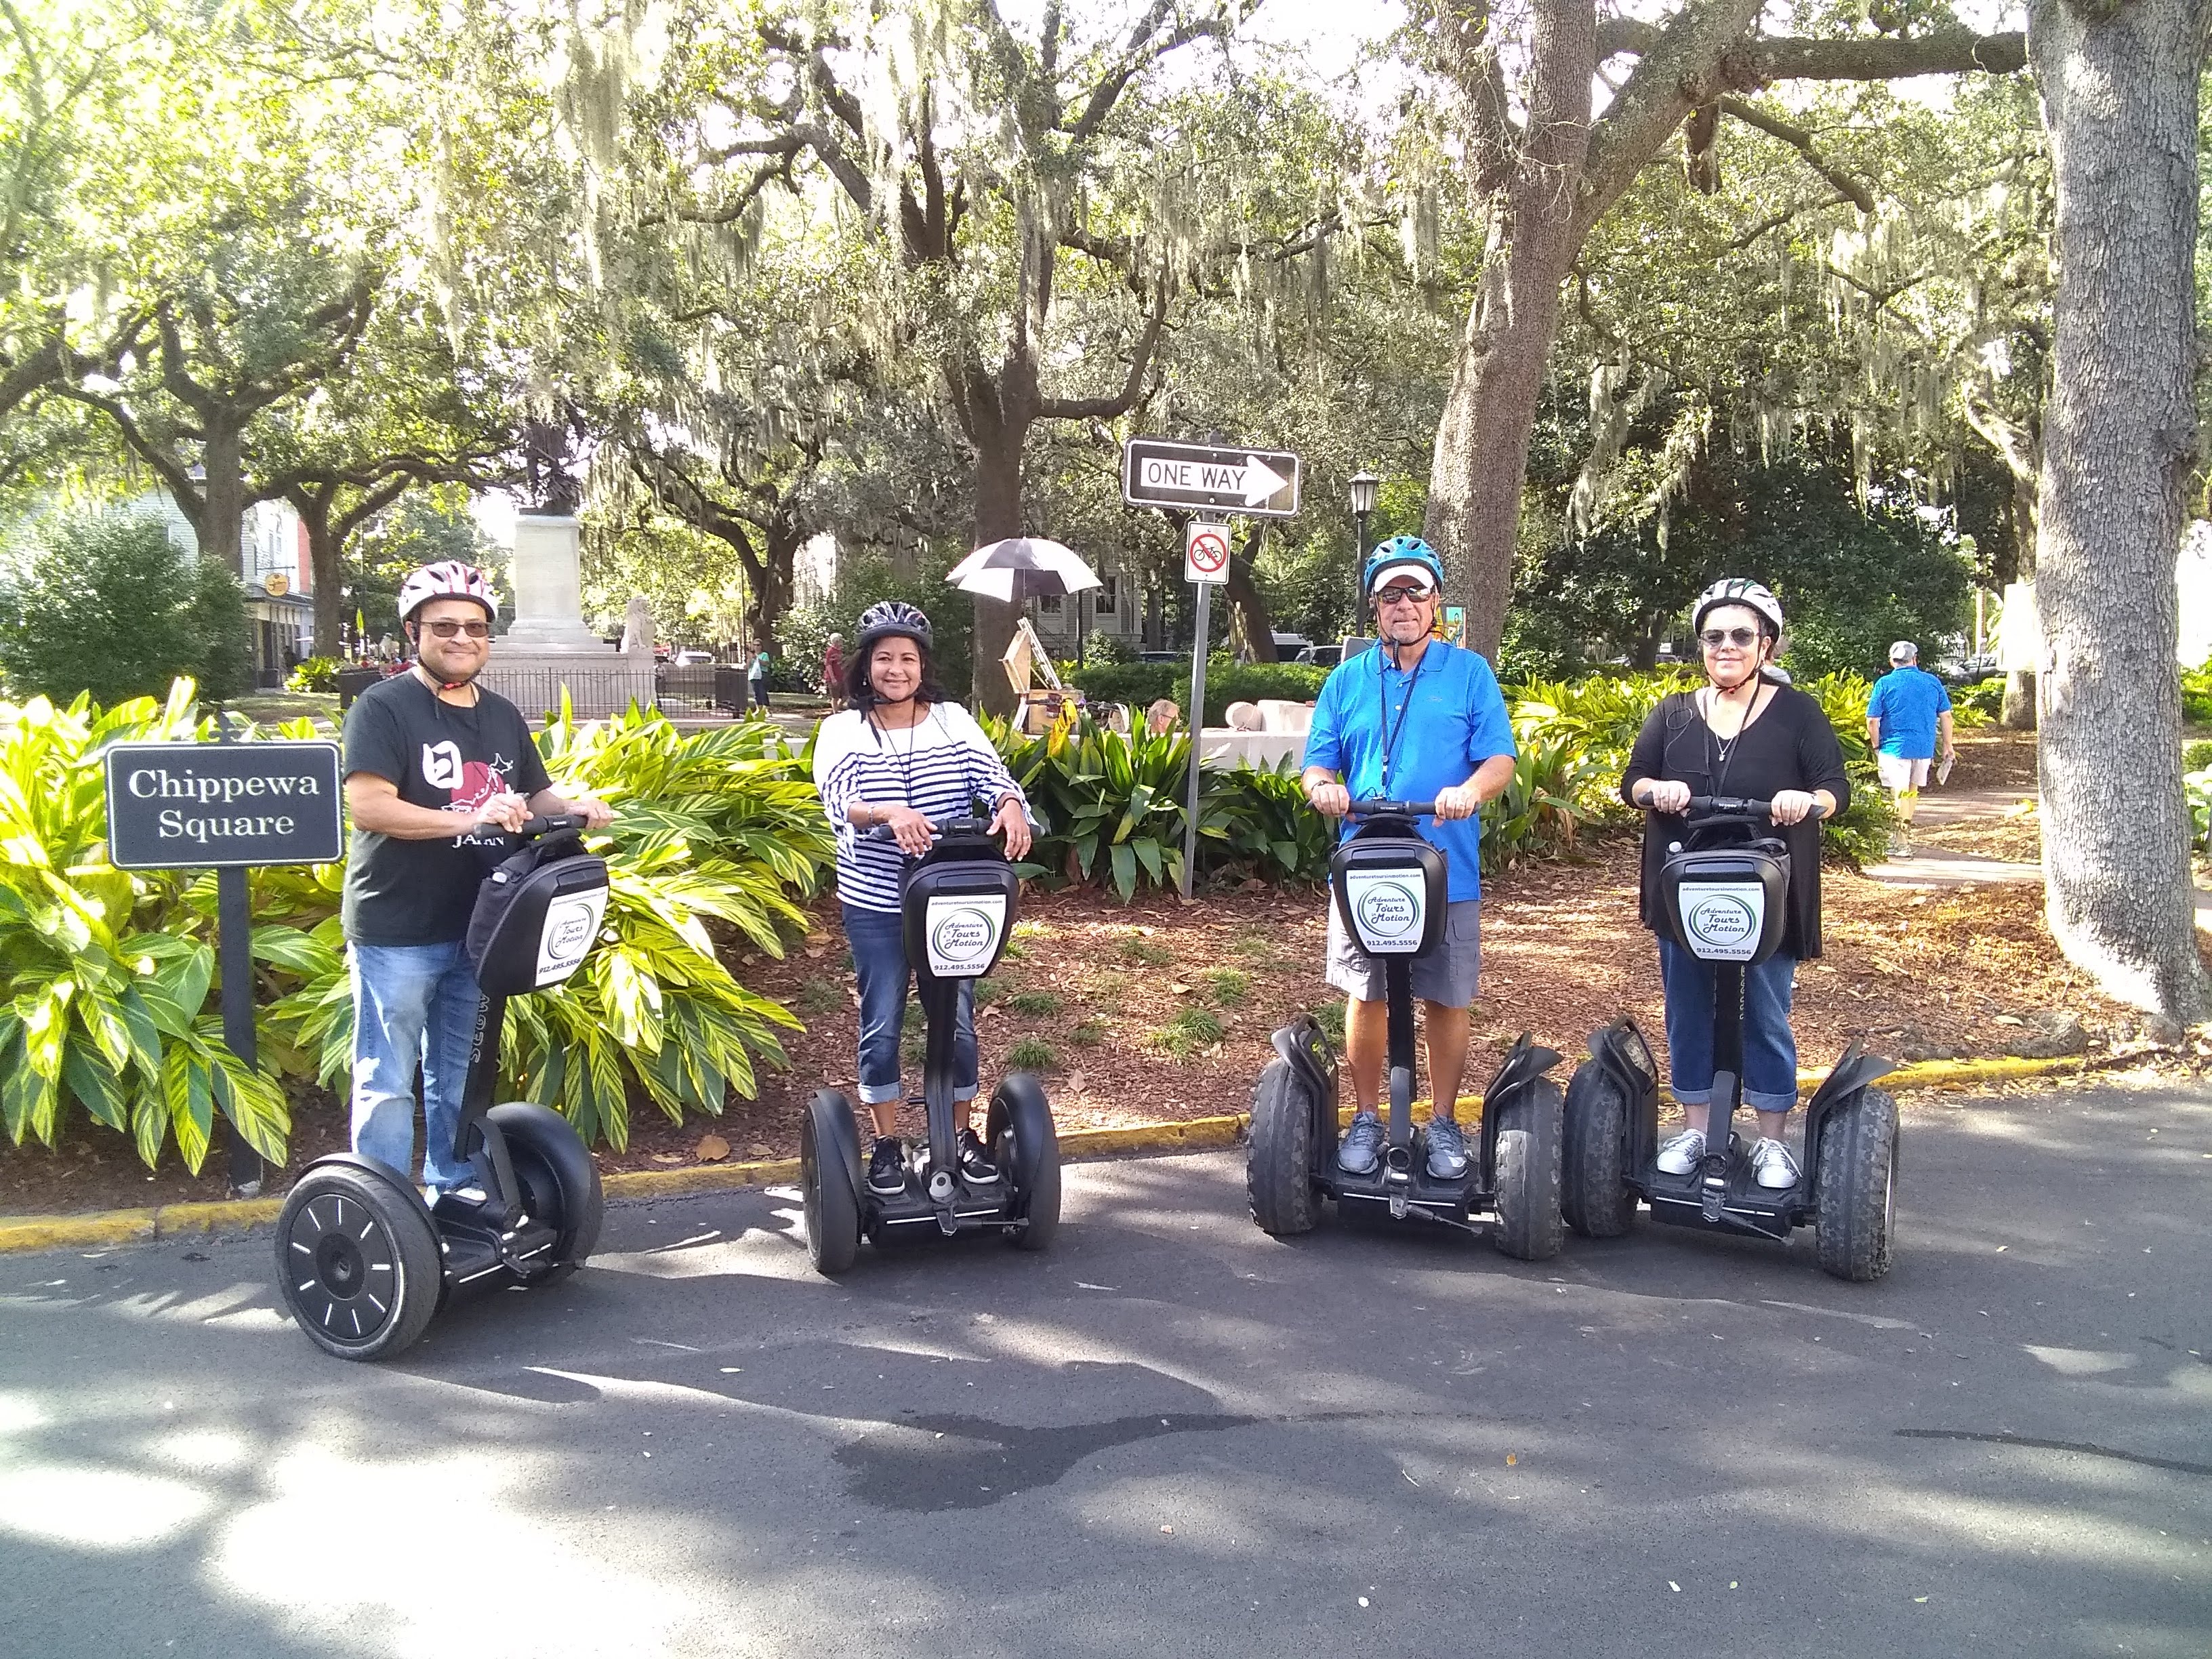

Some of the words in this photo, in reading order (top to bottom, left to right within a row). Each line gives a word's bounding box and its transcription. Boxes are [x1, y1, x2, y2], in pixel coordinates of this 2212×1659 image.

[1148, 462, 1191, 487] ONE
[1202, 466, 1247, 491] WAY
[129, 769, 320, 803] Chippewa
[159, 809, 295, 844] Square
[452, 835, 505, 848] JAAN
[1376, 903, 1404, 913] Tours
[1370, 914, 1410, 924] Motion
[1708, 914, 1740, 924] Tours
[951, 928, 981, 938] Tours
[1702, 924, 1745, 934] Motion
[944, 939, 983, 949] Motion
